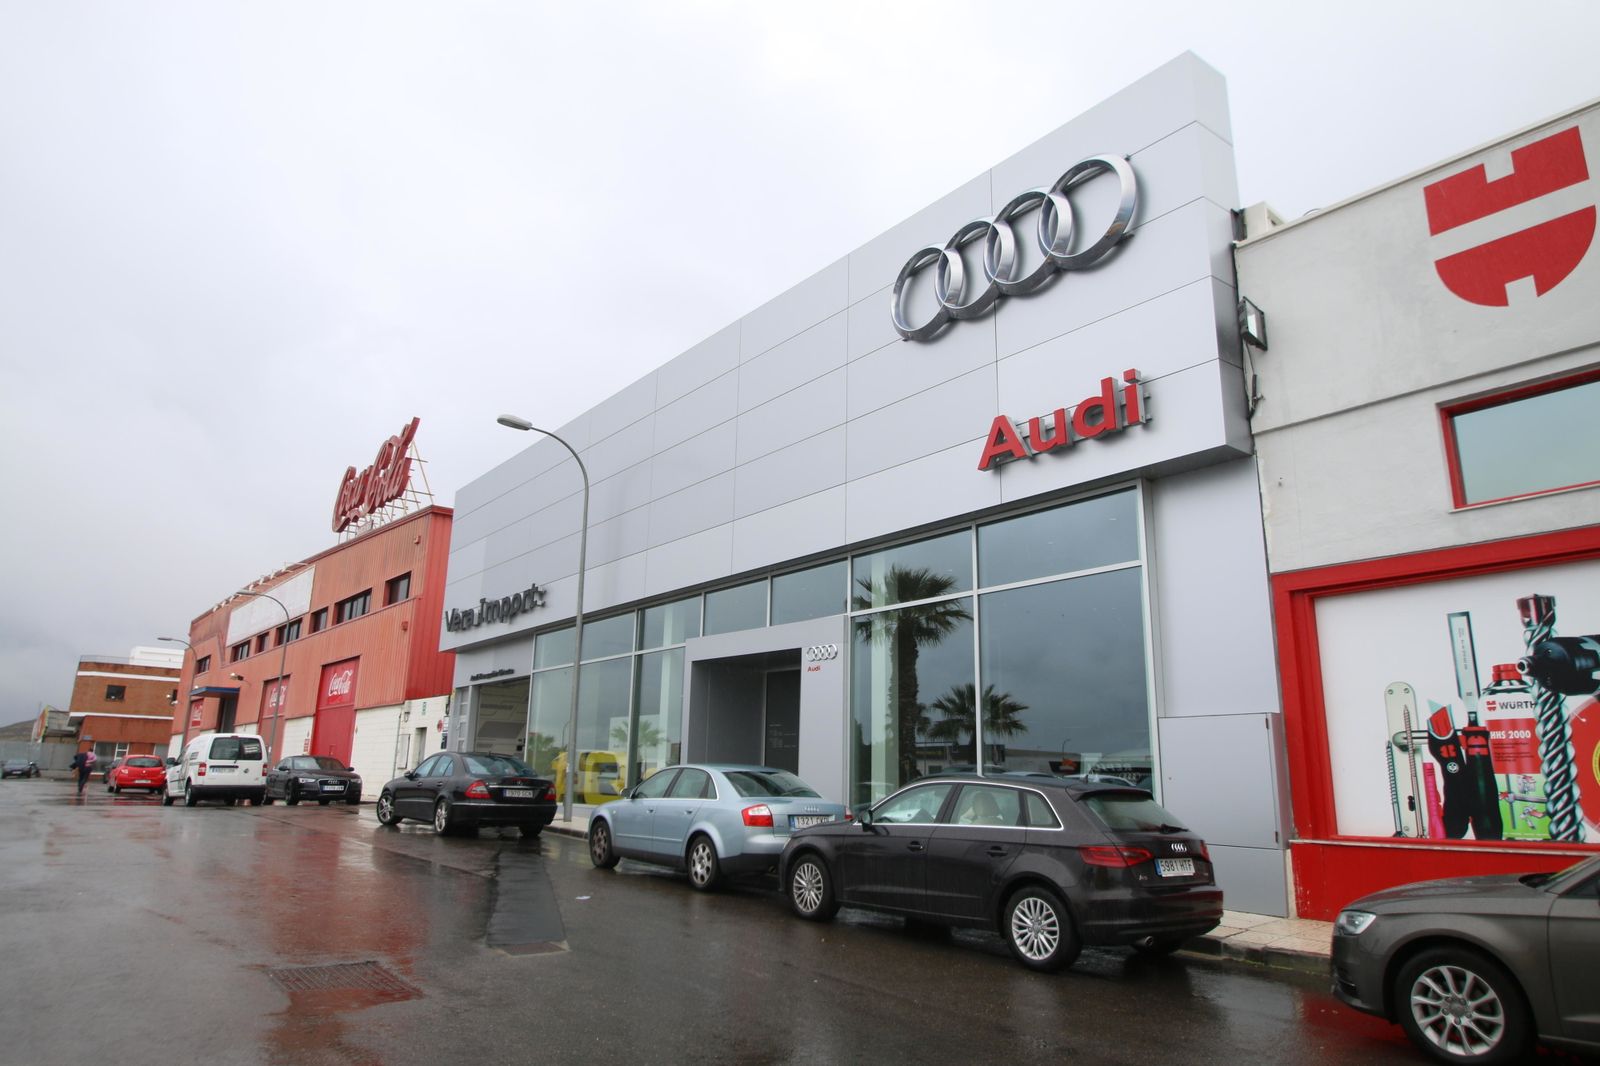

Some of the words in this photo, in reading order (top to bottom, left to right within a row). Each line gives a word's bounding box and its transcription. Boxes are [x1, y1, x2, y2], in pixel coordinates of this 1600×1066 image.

[978, 368, 1143, 470] Audi
[1489, 731, 1506, 740] HHS
[1508, 730, 1532, 739] 2000
[797, 816, 814, 828] 1321
[1161, 860, 1179, 872] 5981
